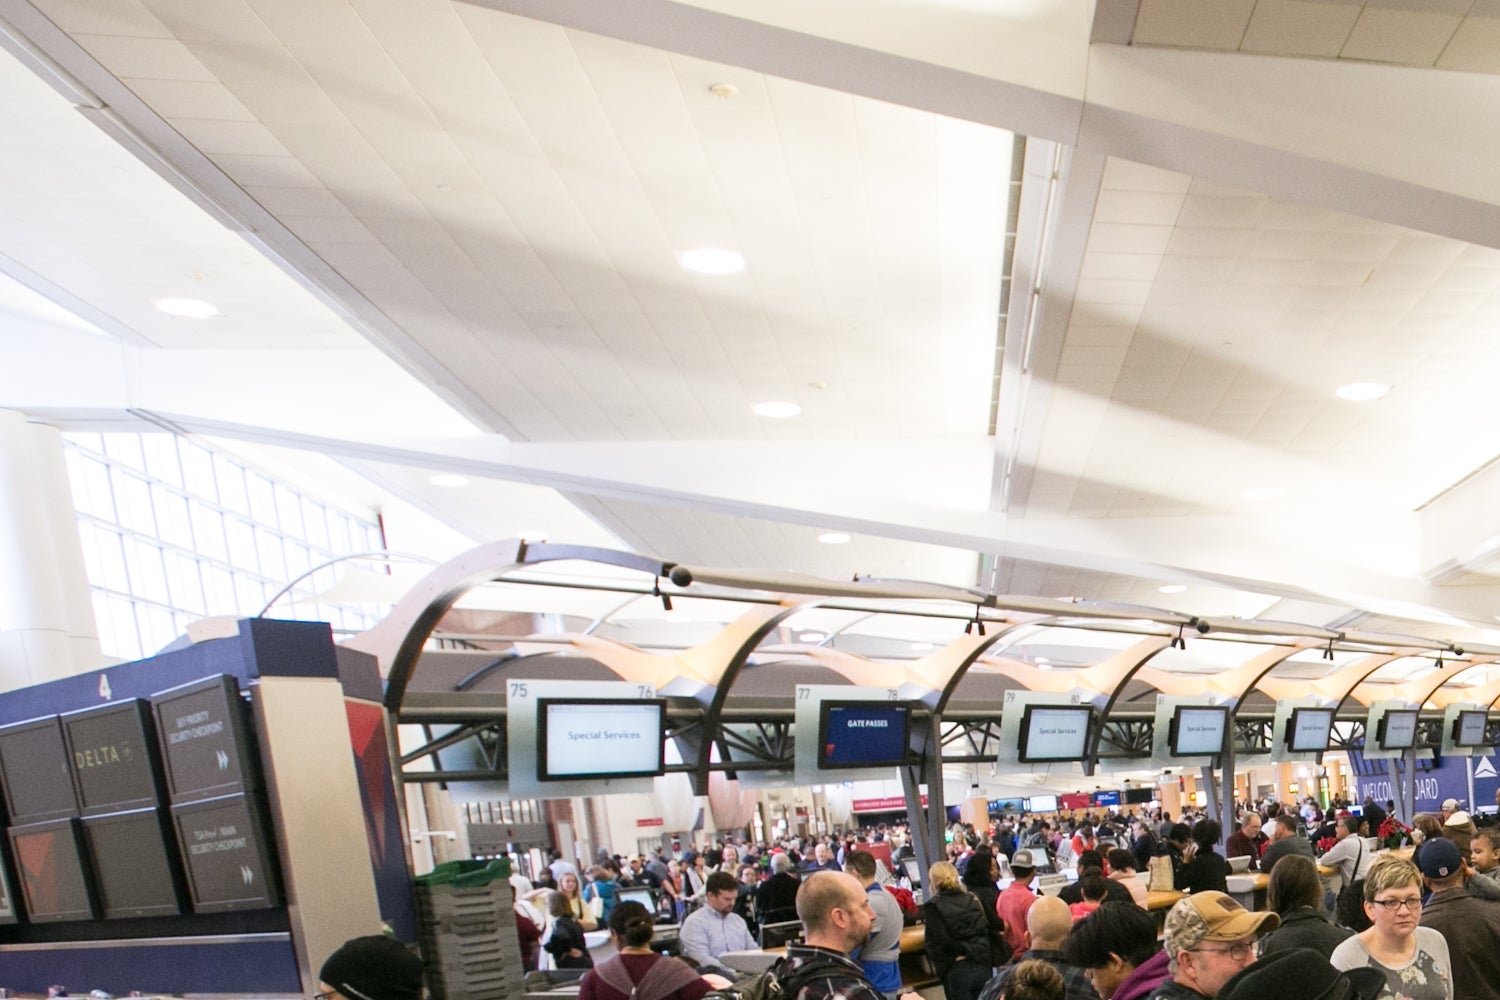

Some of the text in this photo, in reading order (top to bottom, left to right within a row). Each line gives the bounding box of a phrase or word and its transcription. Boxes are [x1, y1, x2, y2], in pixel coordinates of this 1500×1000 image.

[98, 673, 112, 701] 4
[510, 683, 528, 698] 75
[637, 685, 653, 699] 76
[799, 688, 811, 700] 77
[887, 689, 899, 701] 78
[1005, 692, 1016, 703] 79
[1070, 694, 1080, 704] 80
[847, 719, 889, 728] GATE PASSES
[567, 731, 641, 740] Special Services
[1039, 727, 1077, 735] Special Services
[75, 745, 120, 769] DELTA
